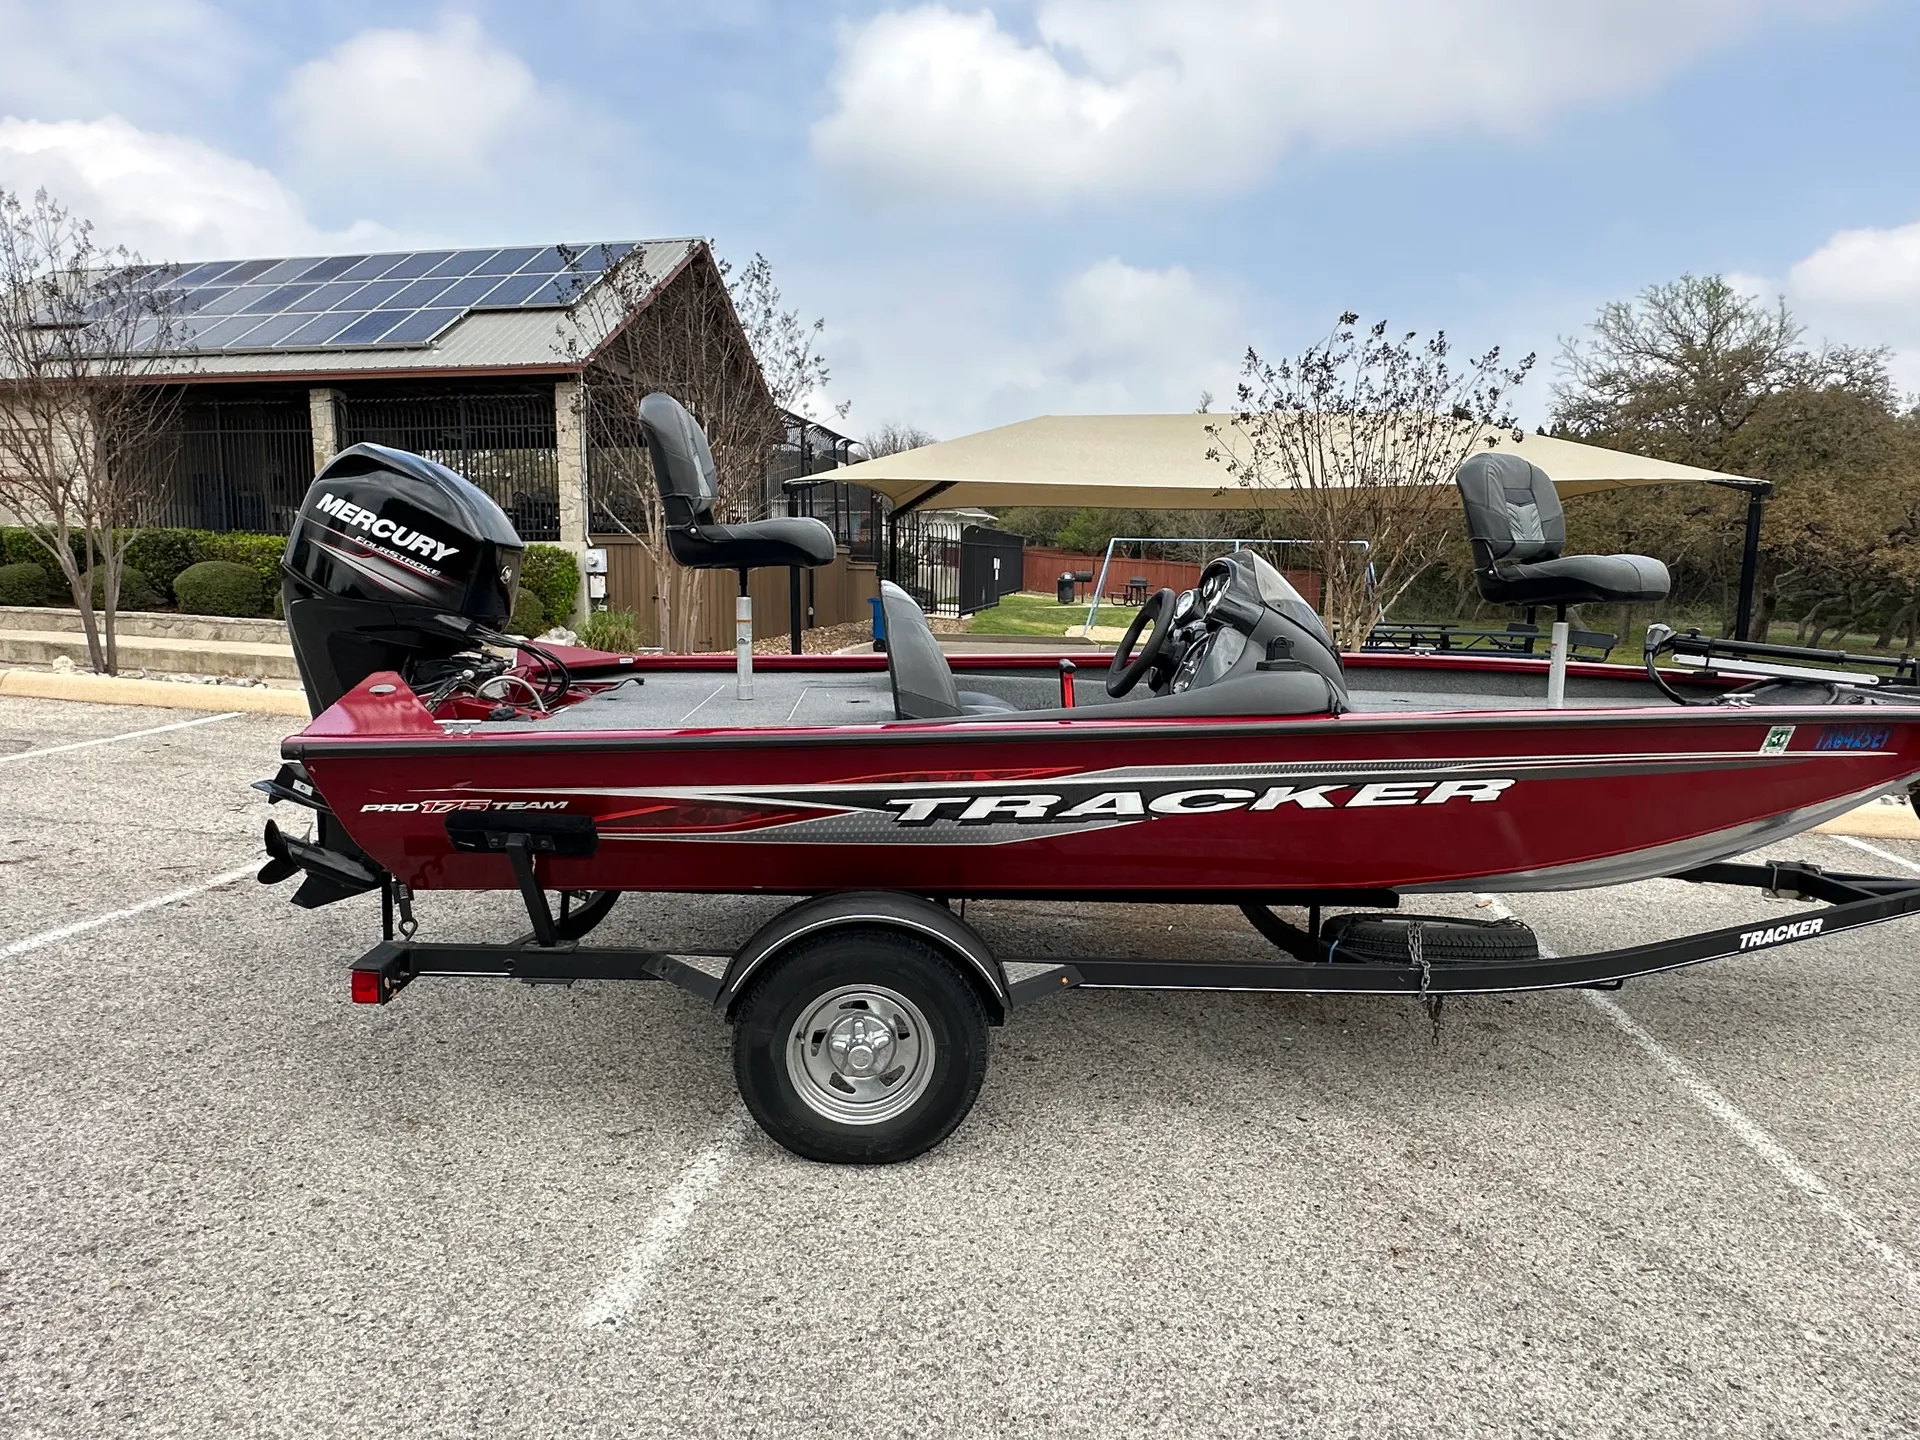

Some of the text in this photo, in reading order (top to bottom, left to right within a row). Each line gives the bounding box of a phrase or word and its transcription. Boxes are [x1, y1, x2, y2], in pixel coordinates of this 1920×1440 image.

[315, 492, 460, 562] MERCURY
[355, 535, 442, 577] FOURSTROKE
[359, 799, 569, 814] PRO 175 TEAM
[884, 777, 1518, 822] TRACKER
[1739, 918, 1824, 949] TRACKER
